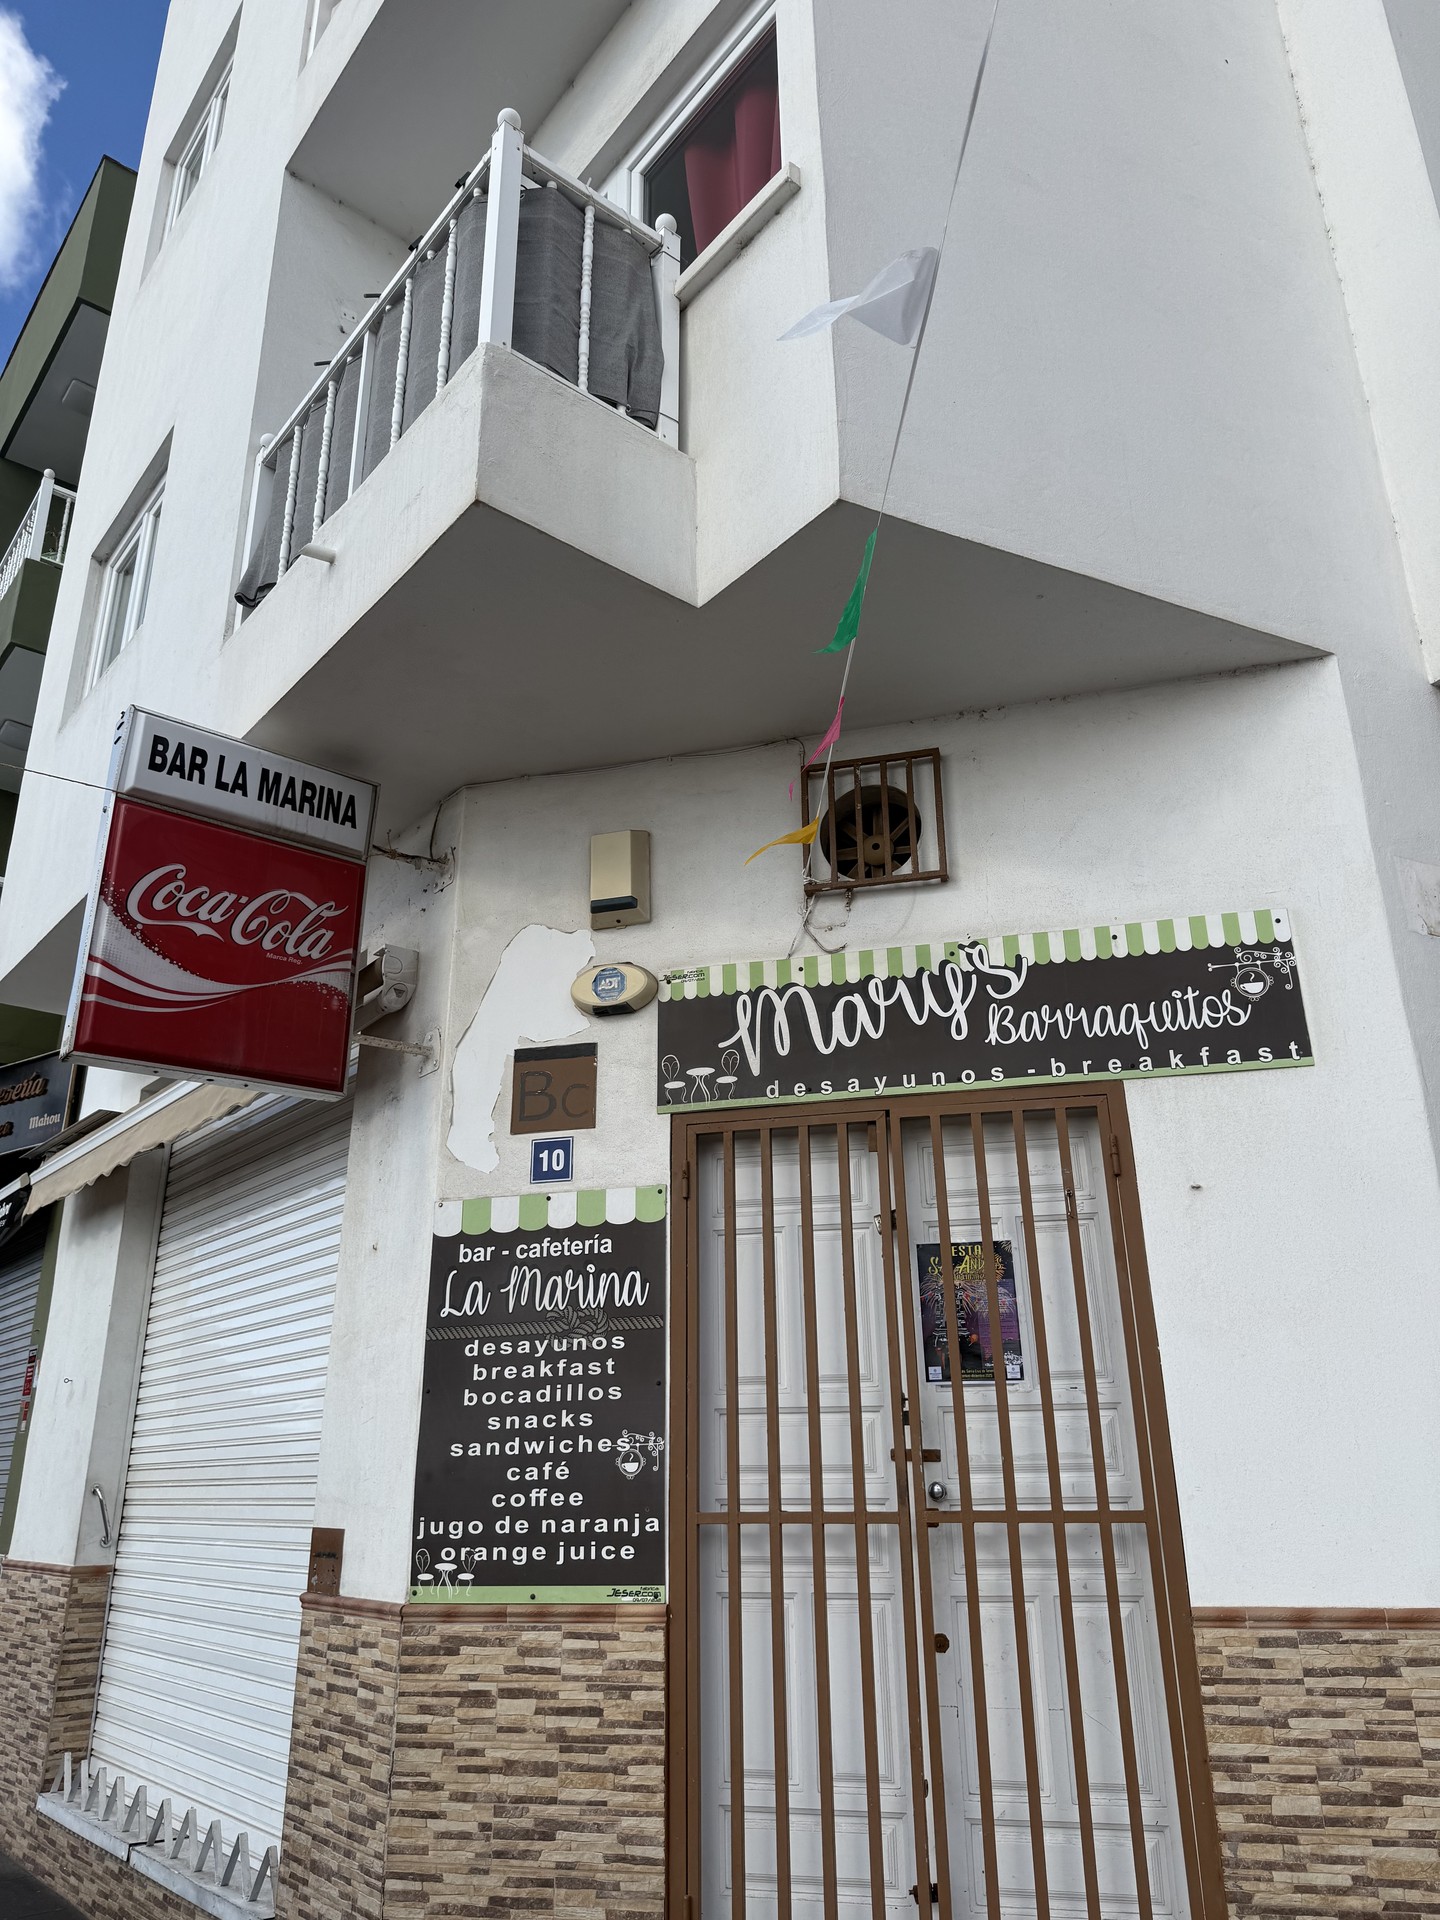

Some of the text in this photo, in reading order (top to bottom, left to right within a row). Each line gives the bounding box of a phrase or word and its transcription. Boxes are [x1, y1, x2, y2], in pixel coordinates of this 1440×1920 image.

[148, 734, 358, 829] BAR LA MARINA
[265, 952, 288, 961] Marca
[984, 985, 1252, 1050] Barraquitos
[29, 1113, 61, 1130] Mahou
[539, 1148, 565, 1171] 10
[458, 1243, 495, 1263] bar
[515, 1234, 613, 1259] cafetería
[440, 1263, 650, 1317] La Marina
[464, 1335, 626, 1357] desayunos
[473, 1357, 616, 1381] breakfast
[463, 1383, 623, 1406] bocadillos
[487, 1409, 594, 1430] snacks
[450, 1435, 631, 1457] sandwiches
[506, 1461, 571, 1481] café
[491, 1488, 584, 1508] coffee
[416, 1513, 660, 1539] jugo de naranja
[440, 1541, 635, 1565] orange juice
